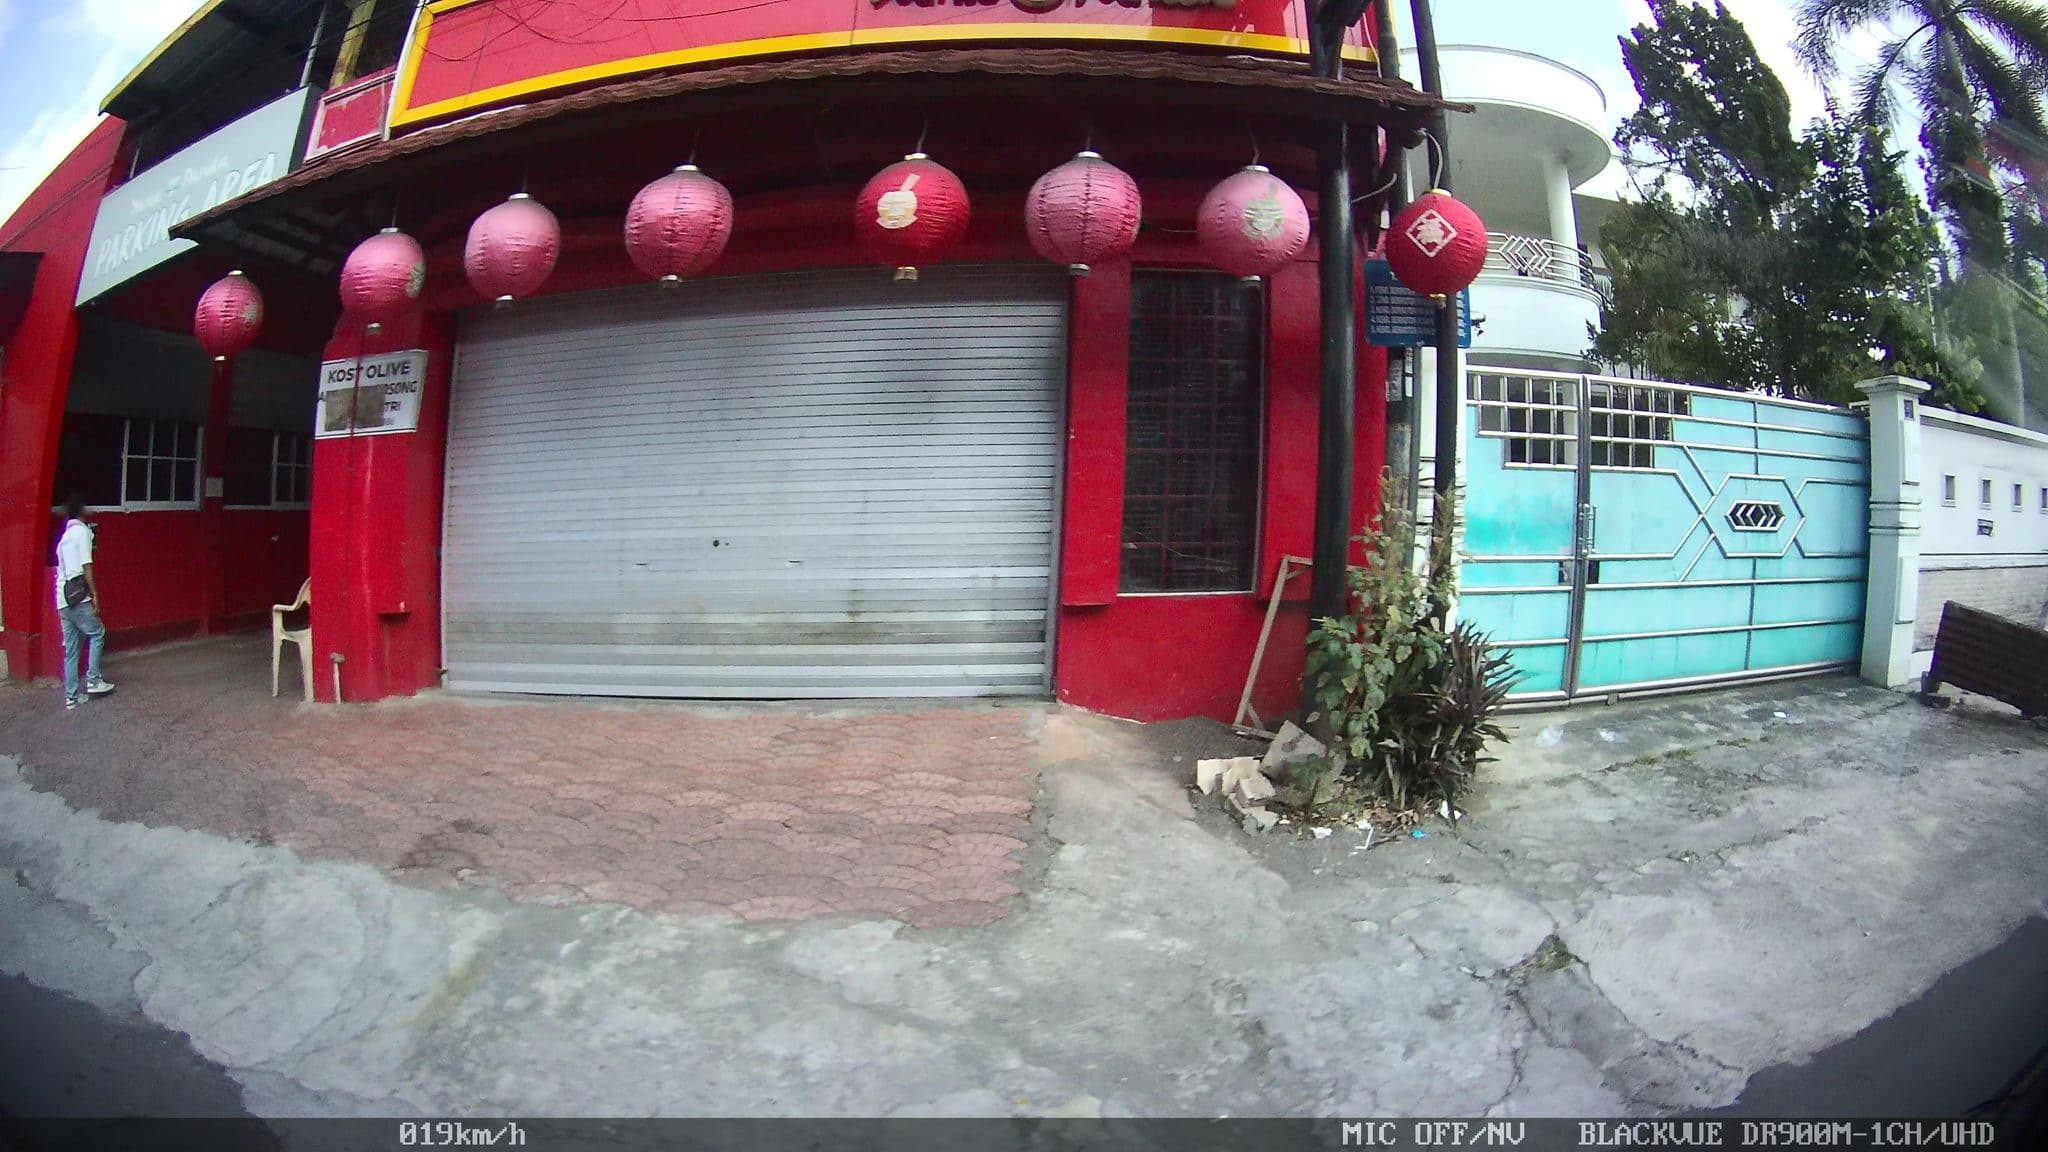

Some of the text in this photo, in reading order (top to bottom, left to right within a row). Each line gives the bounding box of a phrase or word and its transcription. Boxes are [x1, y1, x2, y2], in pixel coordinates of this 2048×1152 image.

[94, 194, 191, 278] PARKING
[203, 152, 276, 208] AREA
[327, 360, 411, 384] KOST OLIVE
[384, 401, 402, 412] TRI
